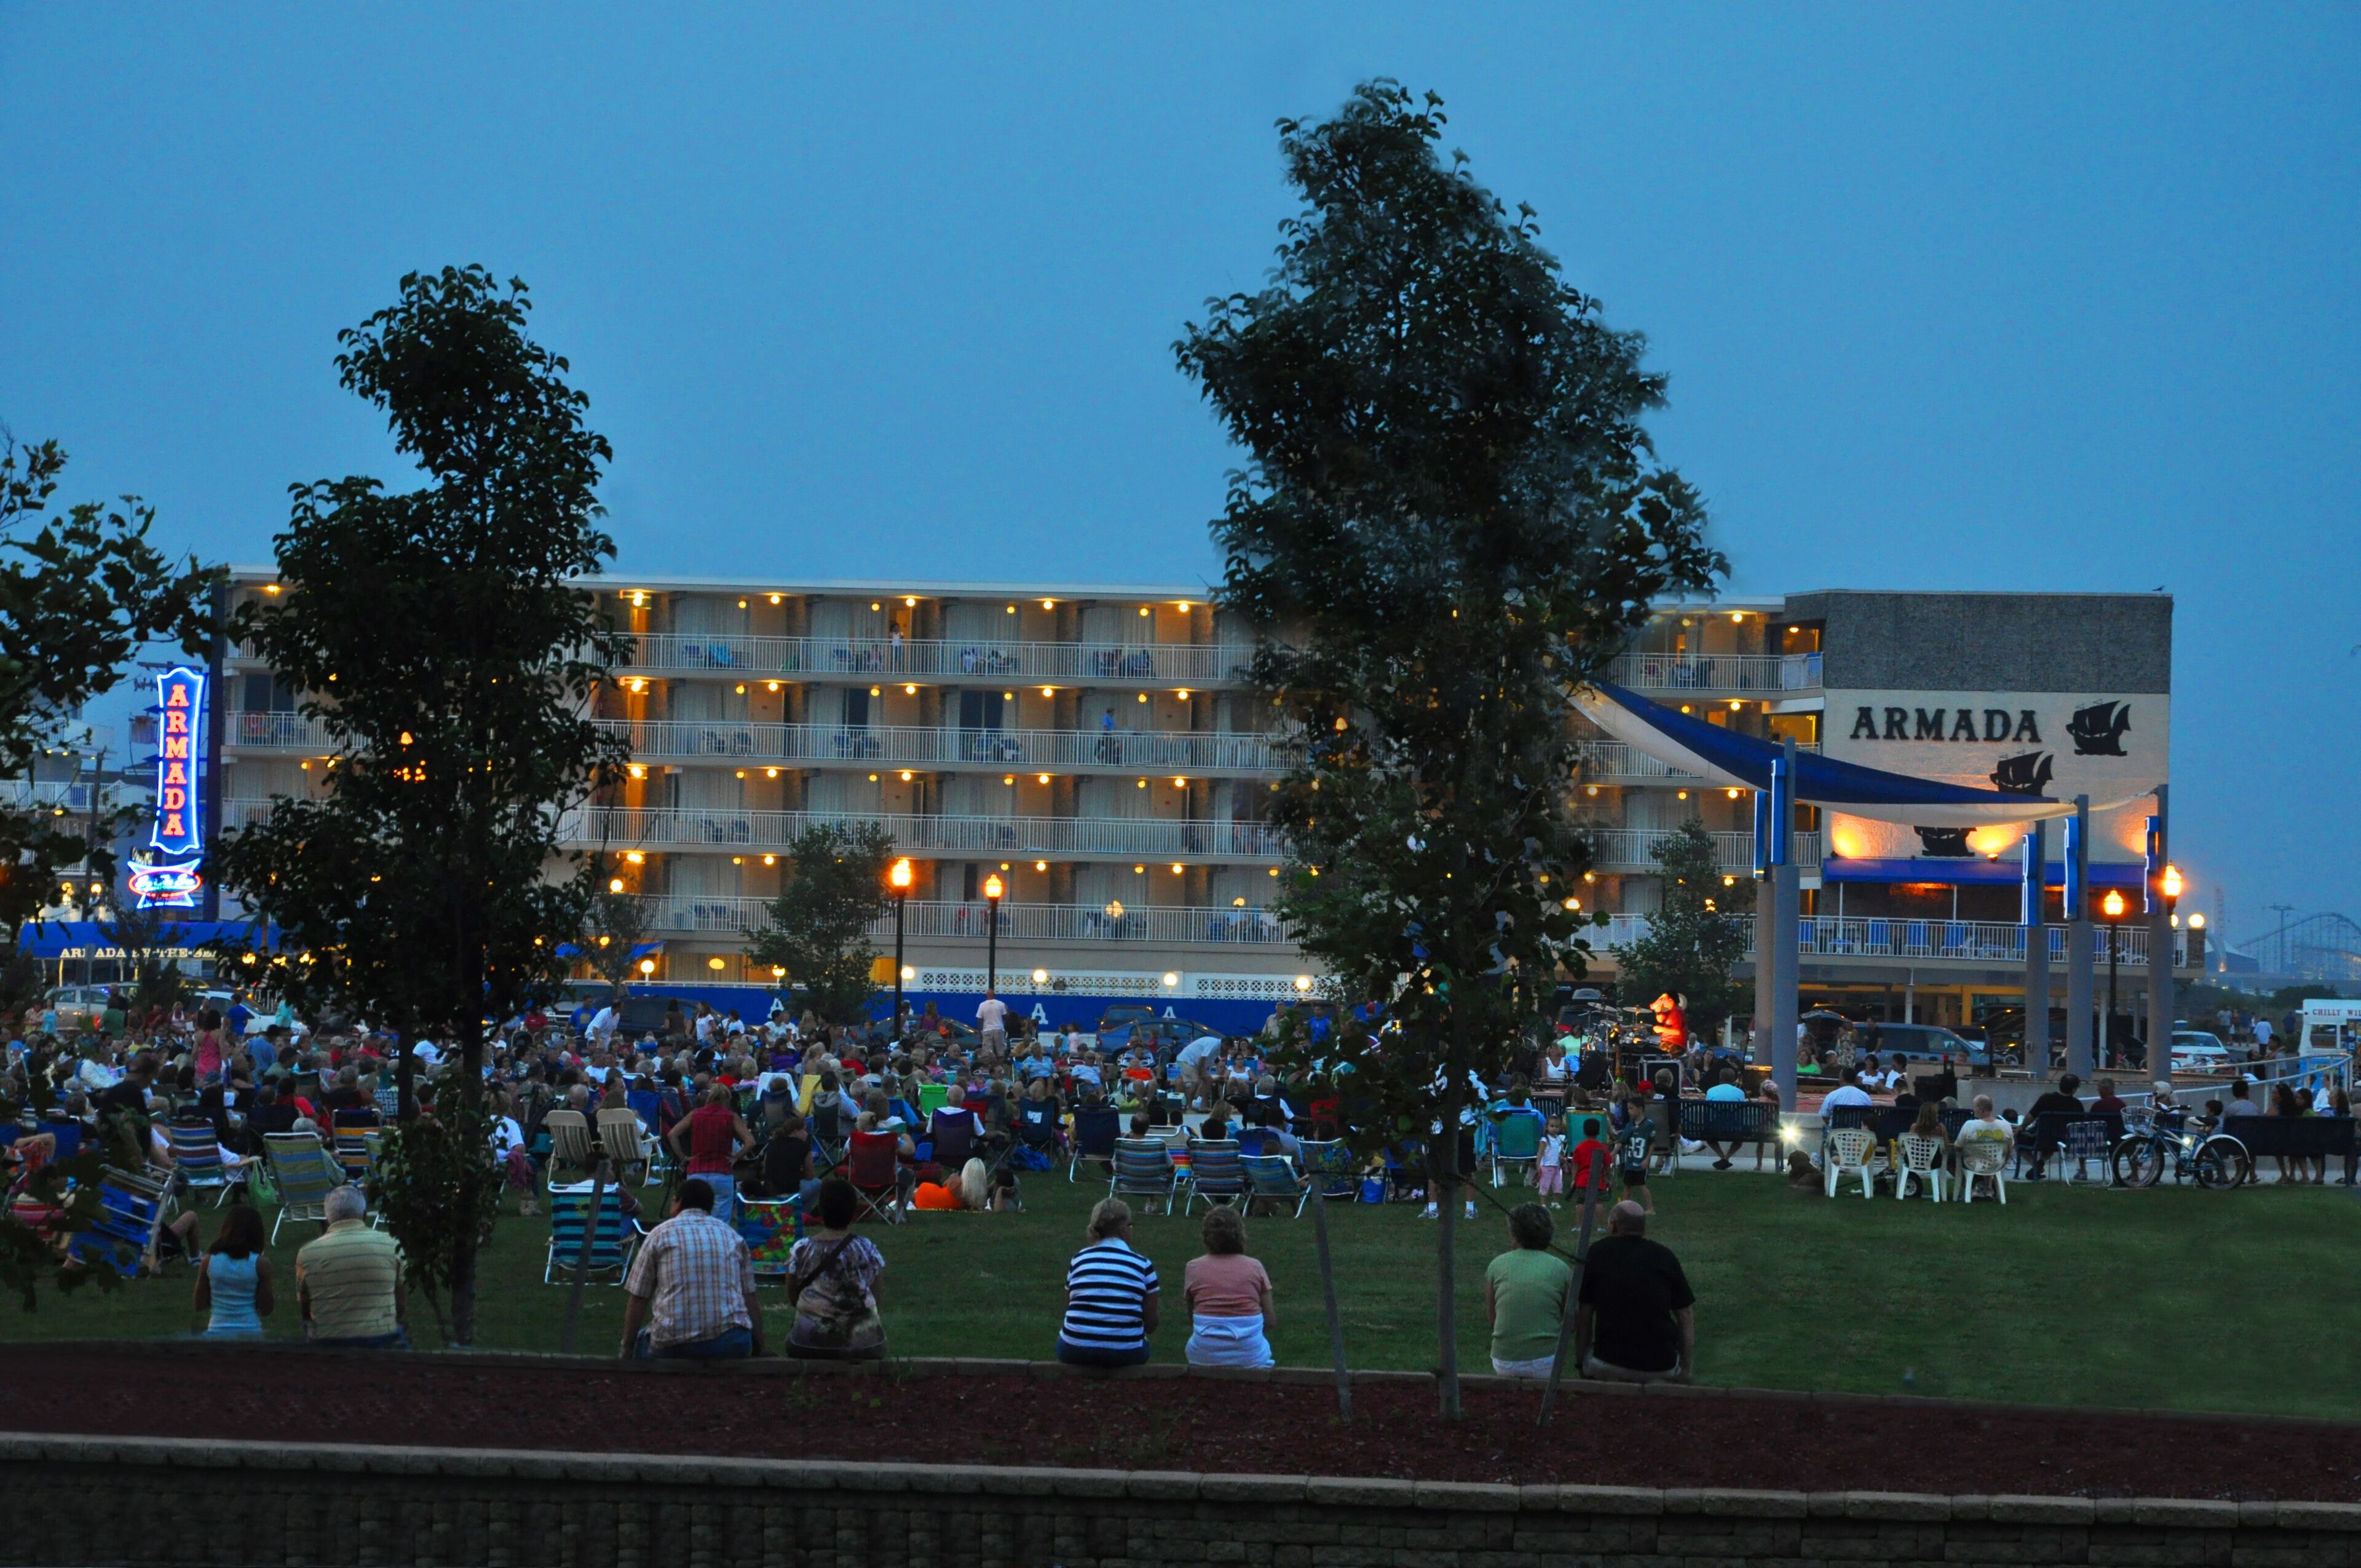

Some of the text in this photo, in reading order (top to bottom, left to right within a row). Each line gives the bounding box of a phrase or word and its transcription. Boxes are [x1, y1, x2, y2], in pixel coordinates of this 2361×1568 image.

[1849, 707, 2042, 742] ARMADA
[162, 684, 189, 836] ARMADA
[60, 948, 127, 958] ARADA
